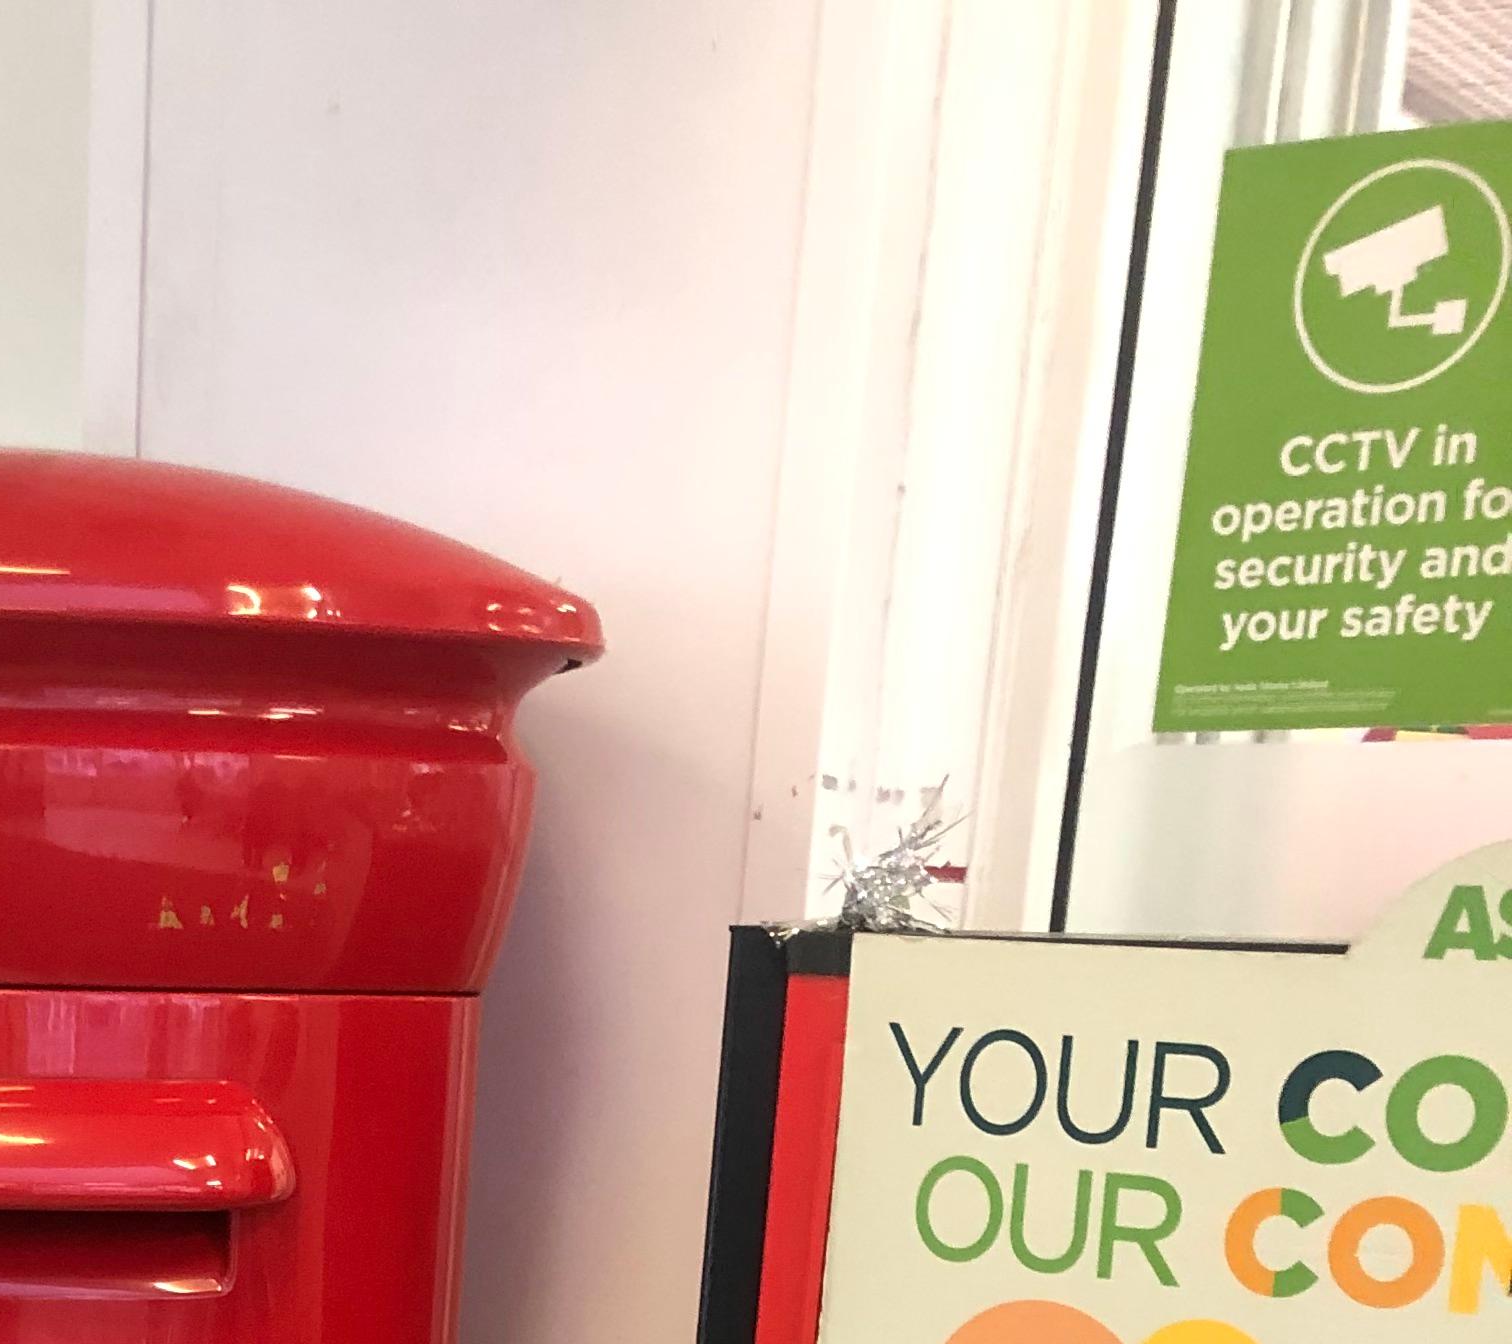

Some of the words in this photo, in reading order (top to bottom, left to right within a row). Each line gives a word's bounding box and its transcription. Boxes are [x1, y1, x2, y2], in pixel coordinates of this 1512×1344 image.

[1279, 426, 1421, 477] CCTV
[1433, 423, 1477, 466] in
[1211, 484, 1447, 543] operation
[1214, 541, 1407, 590] security
[1419, 531, 1512, 579] and
[1218, 607, 1328, 651] your
[1340, 593, 1494, 642] safety
[1422, 885, 1512, 961] A
[889, 1021, 1231, 1154] YOUR
[916, 1154, 1182, 1287] OUR
